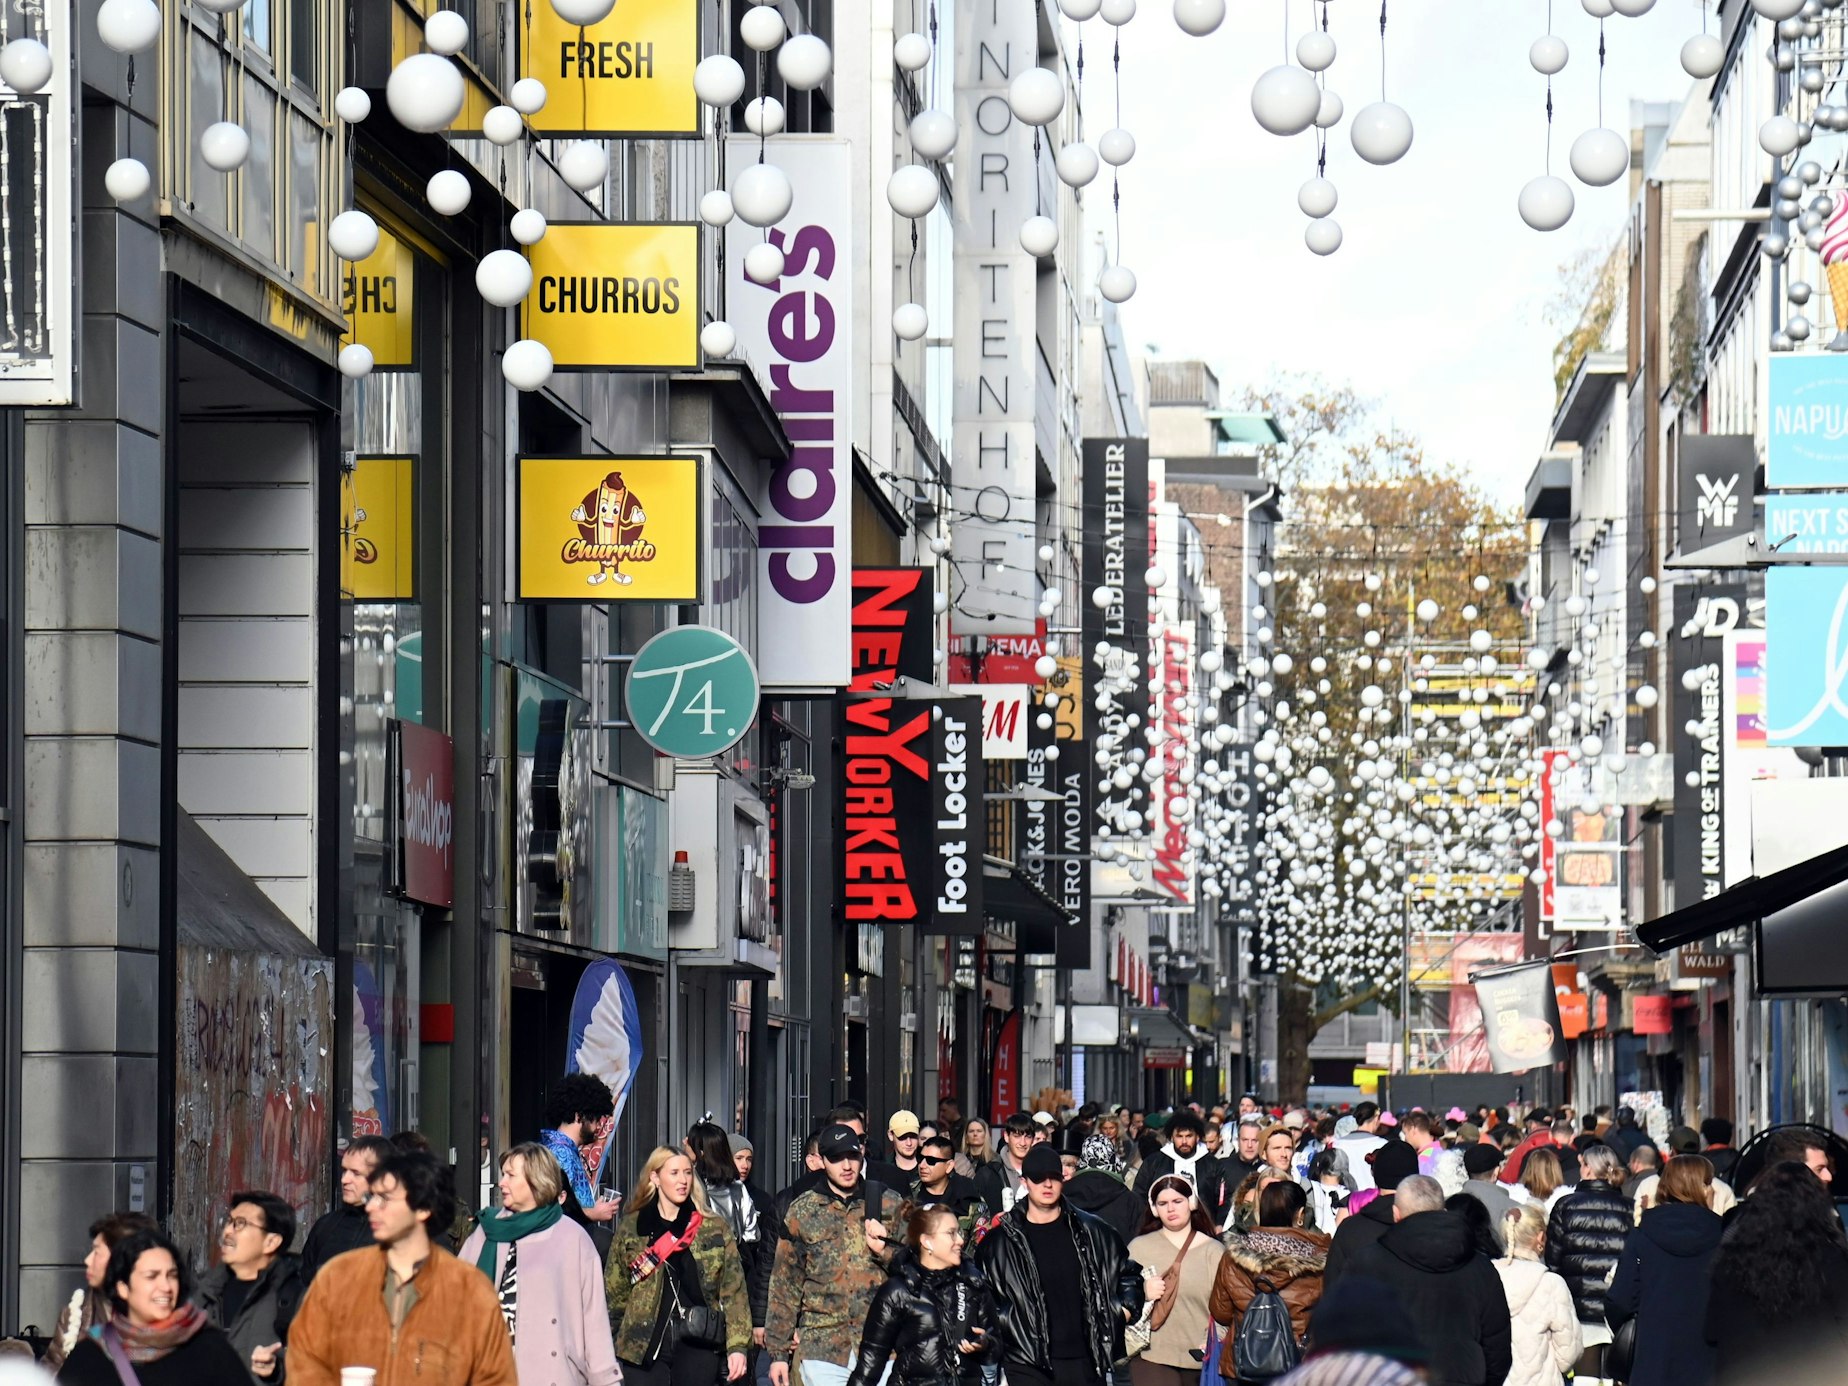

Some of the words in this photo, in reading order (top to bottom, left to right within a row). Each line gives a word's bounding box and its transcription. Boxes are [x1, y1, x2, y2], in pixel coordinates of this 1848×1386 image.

[560, 42, 653, 79] FRESH
[539, 276, 680, 314] CHURROS
[744, 225, 836, 604] claire's
[562, 538, 656, 564] Churrito
[1104, 444, 1125, 637] LEDERATELIER
[1772, 508, 1831, 536] NEXT
[846, 569, 923, 732] NEW
[1700, 663, 1720, 786] TRANERS
[937, 716, 967, 830] Locker
[1701, 787, 1716, 812] OF
[845, 710, 929, 920] YORKER
[1063, 772, 1081, 852] MODA
[1701, 814, 1720, 875] KING
[937, 841, 967, 914] Foot
[1684, 955, 1725, 969] WALD
